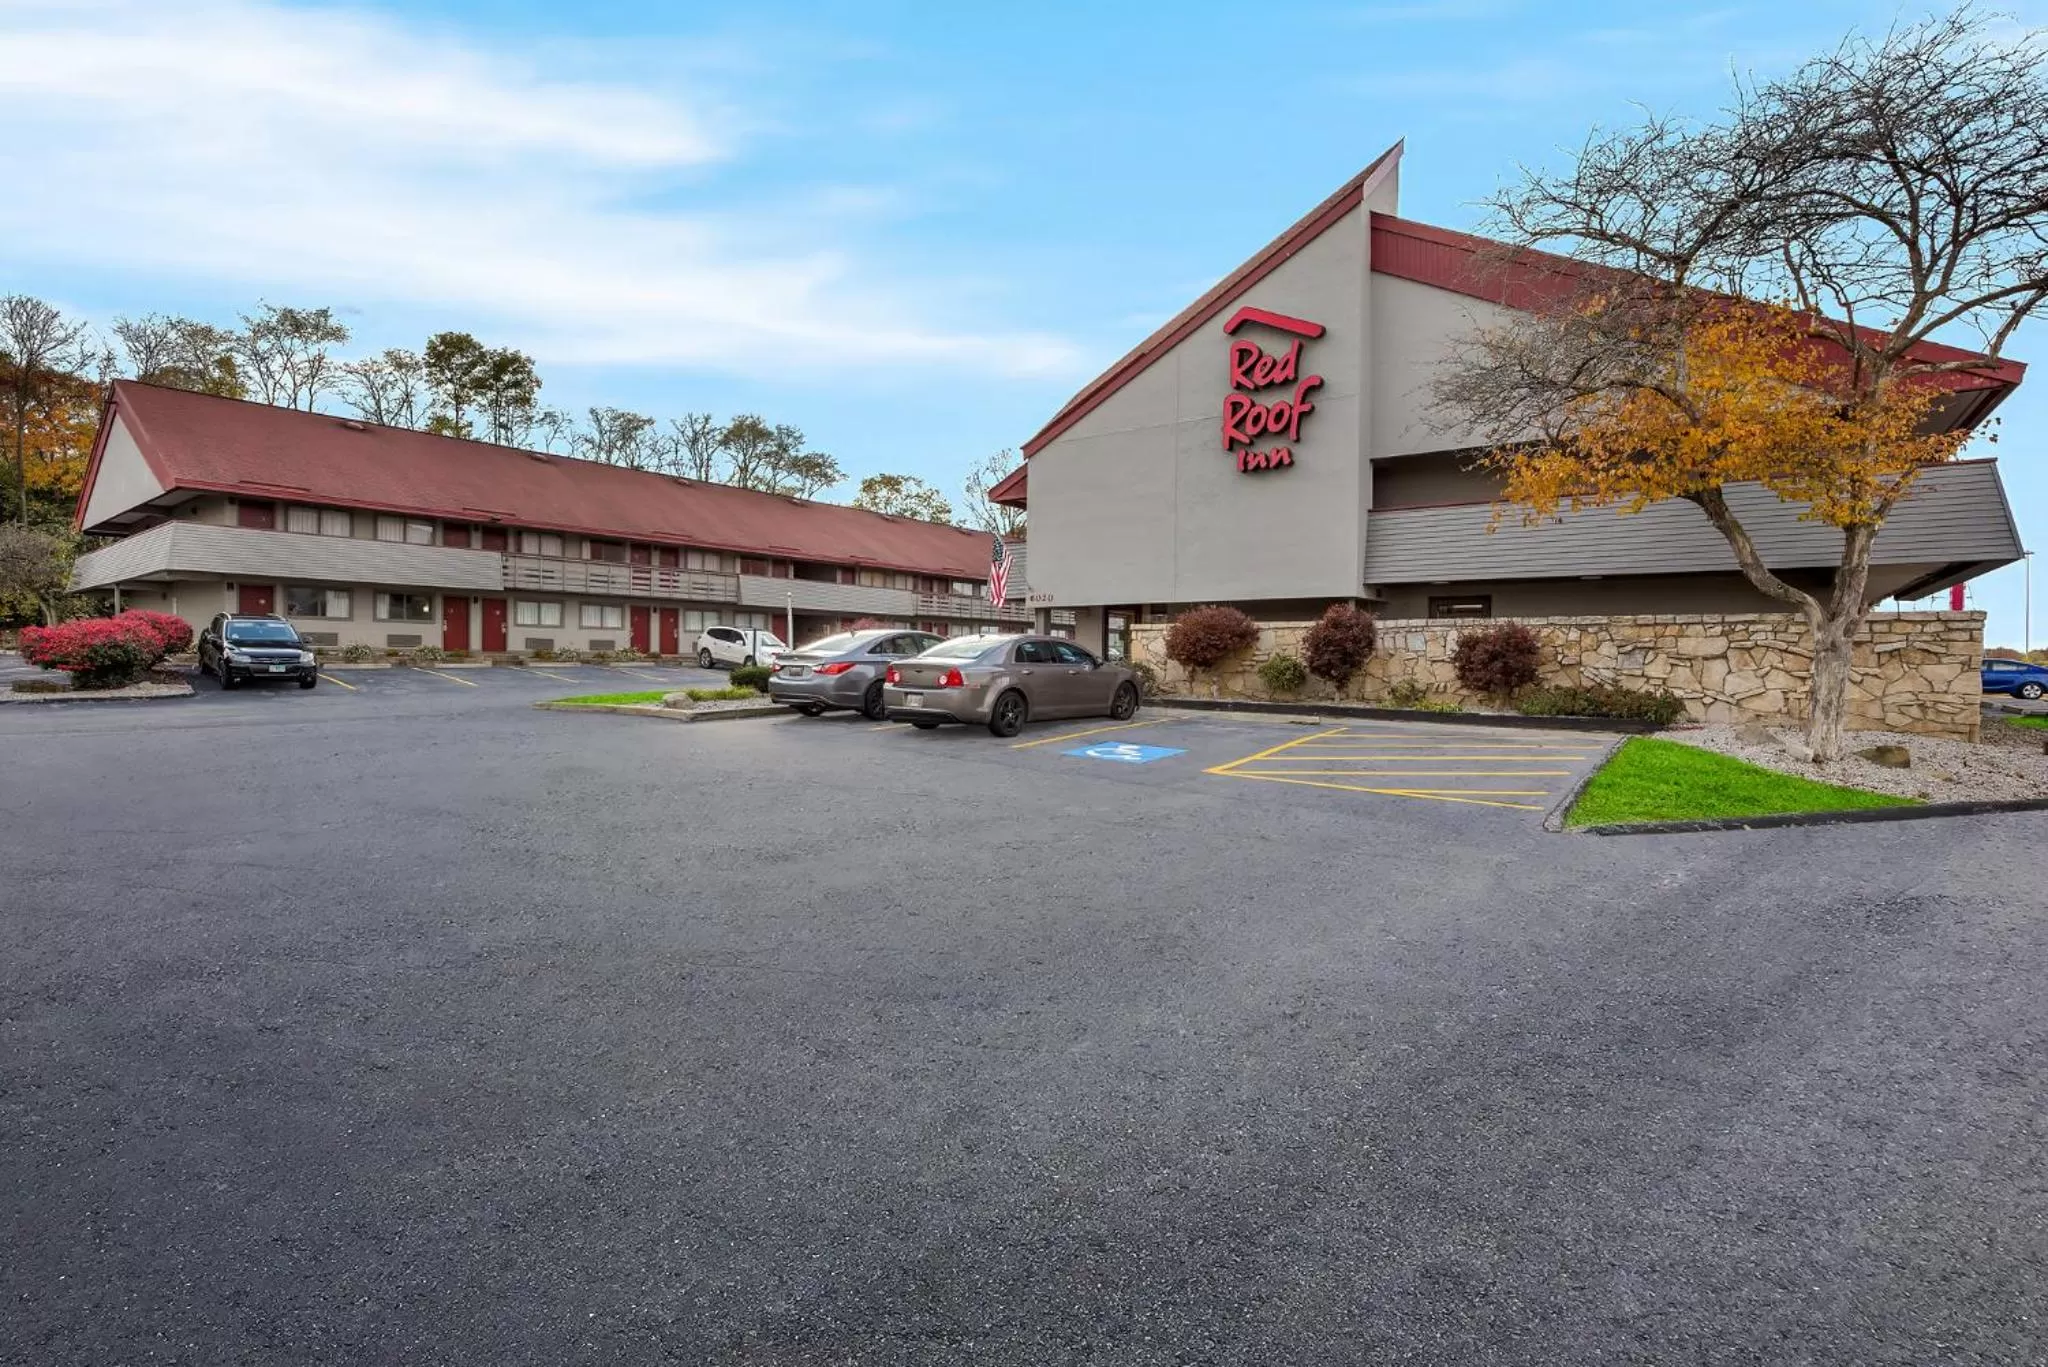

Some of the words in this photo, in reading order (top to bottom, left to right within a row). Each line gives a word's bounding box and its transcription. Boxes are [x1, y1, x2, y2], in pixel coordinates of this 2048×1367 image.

[1230, 338, 1303, 390] Red
[1223, 375, 1323, 450] Roof
[1236, 447, 1294, 473] Inn
